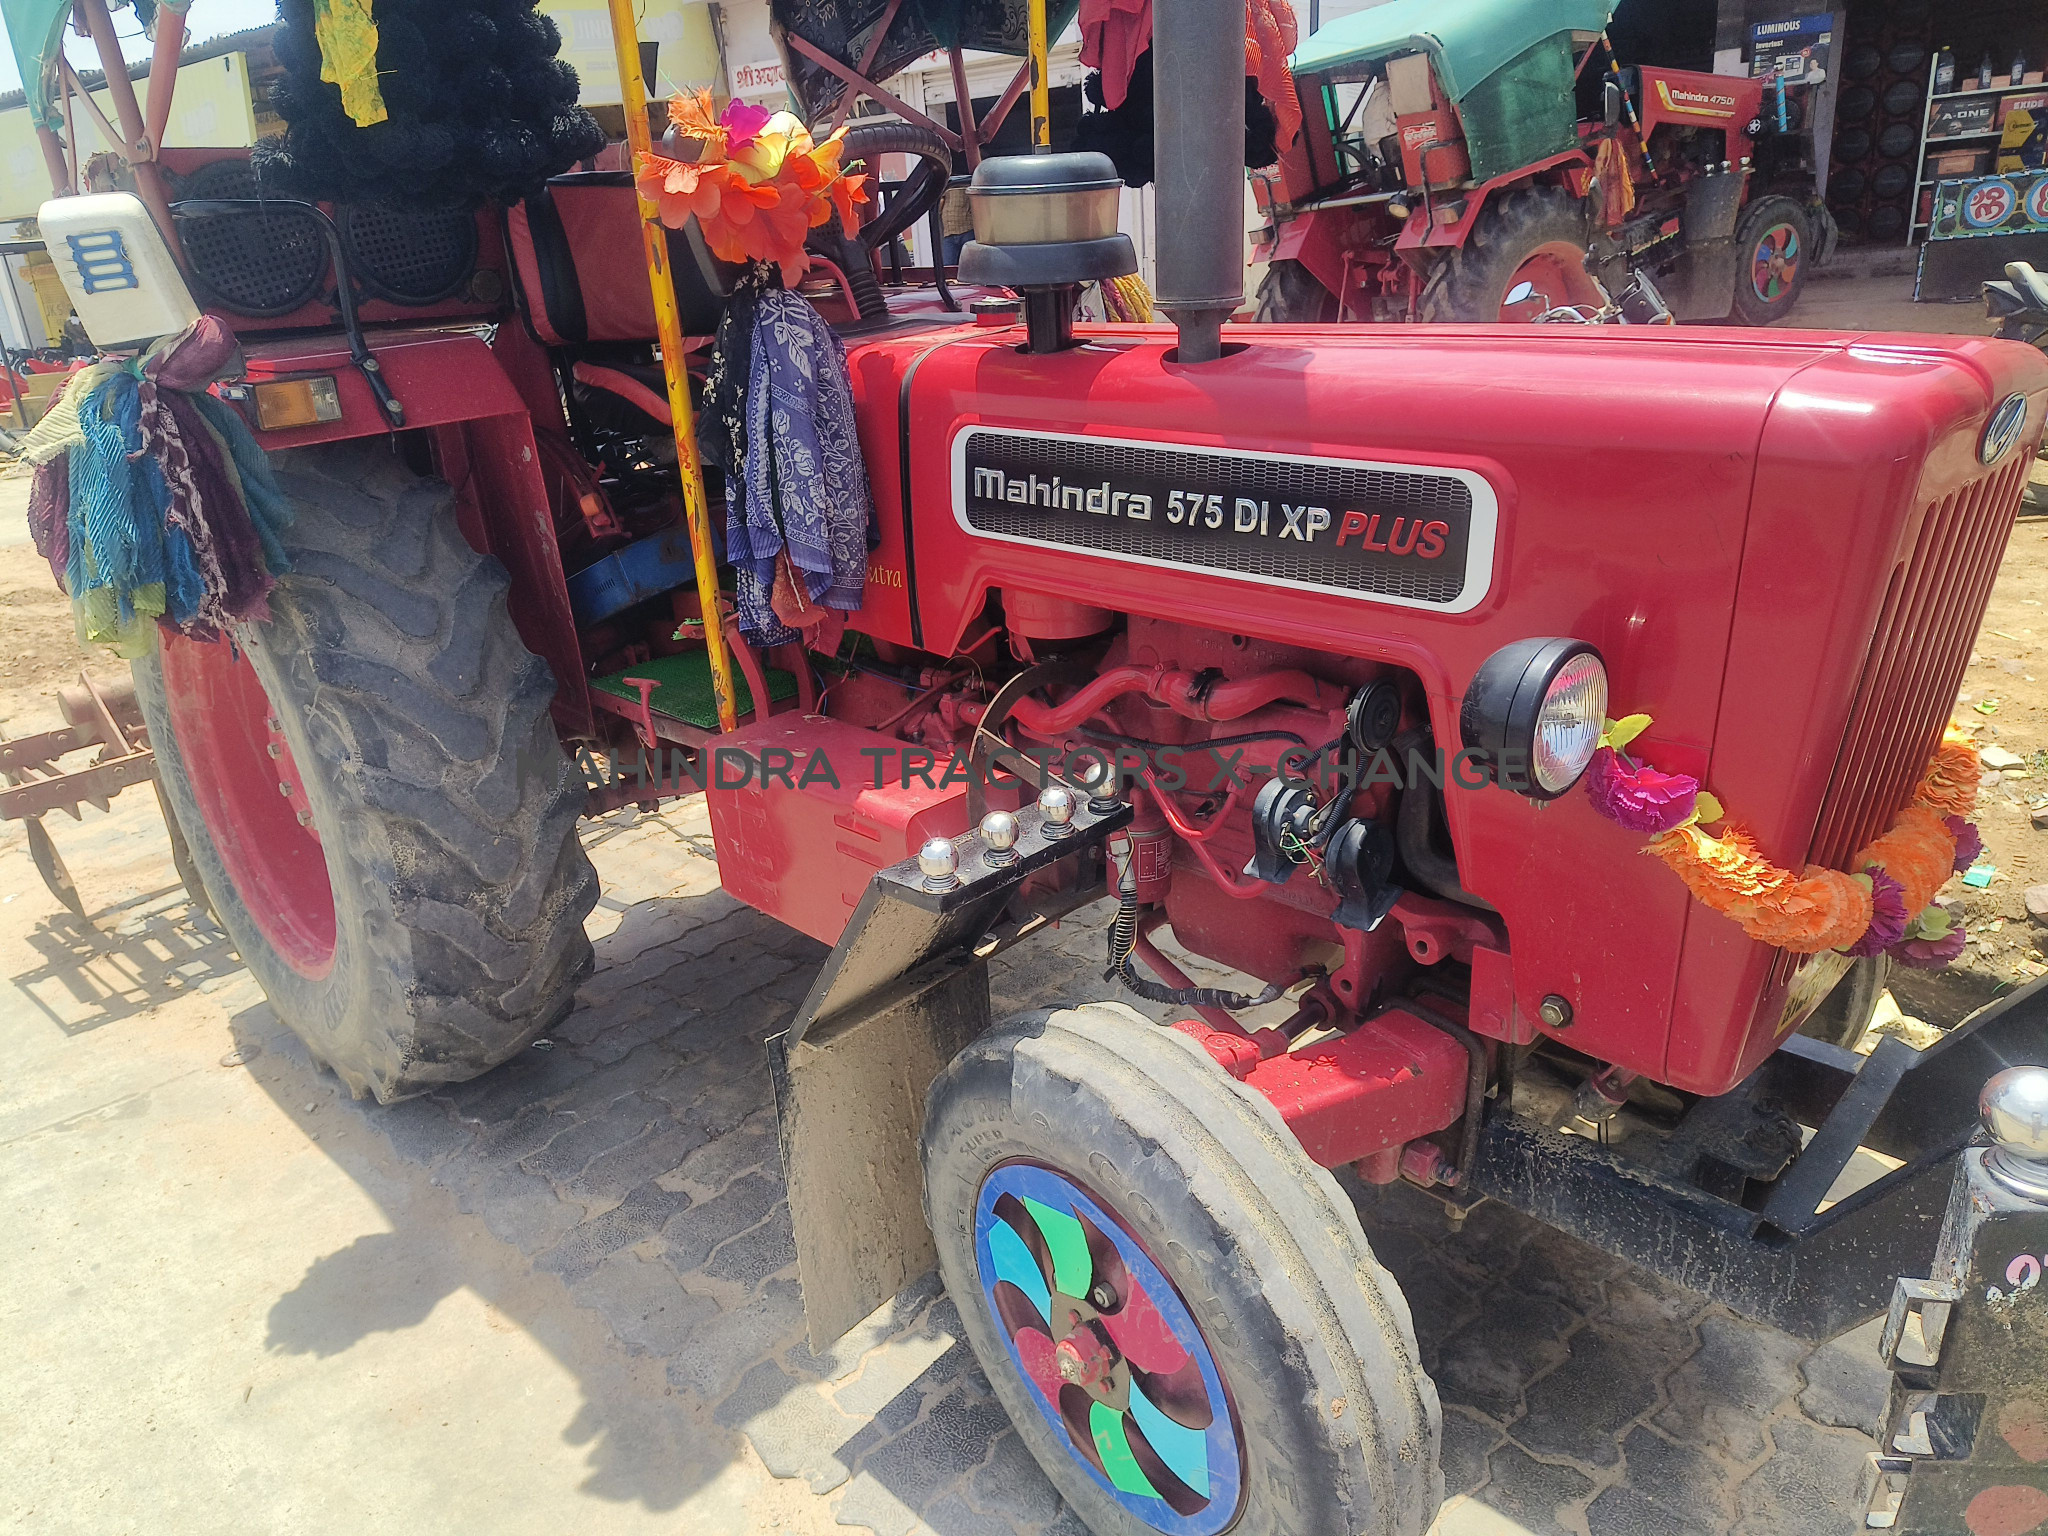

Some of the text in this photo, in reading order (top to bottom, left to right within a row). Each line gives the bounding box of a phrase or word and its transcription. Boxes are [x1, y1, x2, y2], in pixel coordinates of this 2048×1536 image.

[1757, 20, 1800, 35] LUMINOUS
[1671, 89, 1709, 103] Mahindra
[2013, 99, 2045, 110] EXIDE
[1942, 108, 1991, 121] A-ONE
[974, 466, 1452, 560] Mahindra 575 DI XP PLUS
